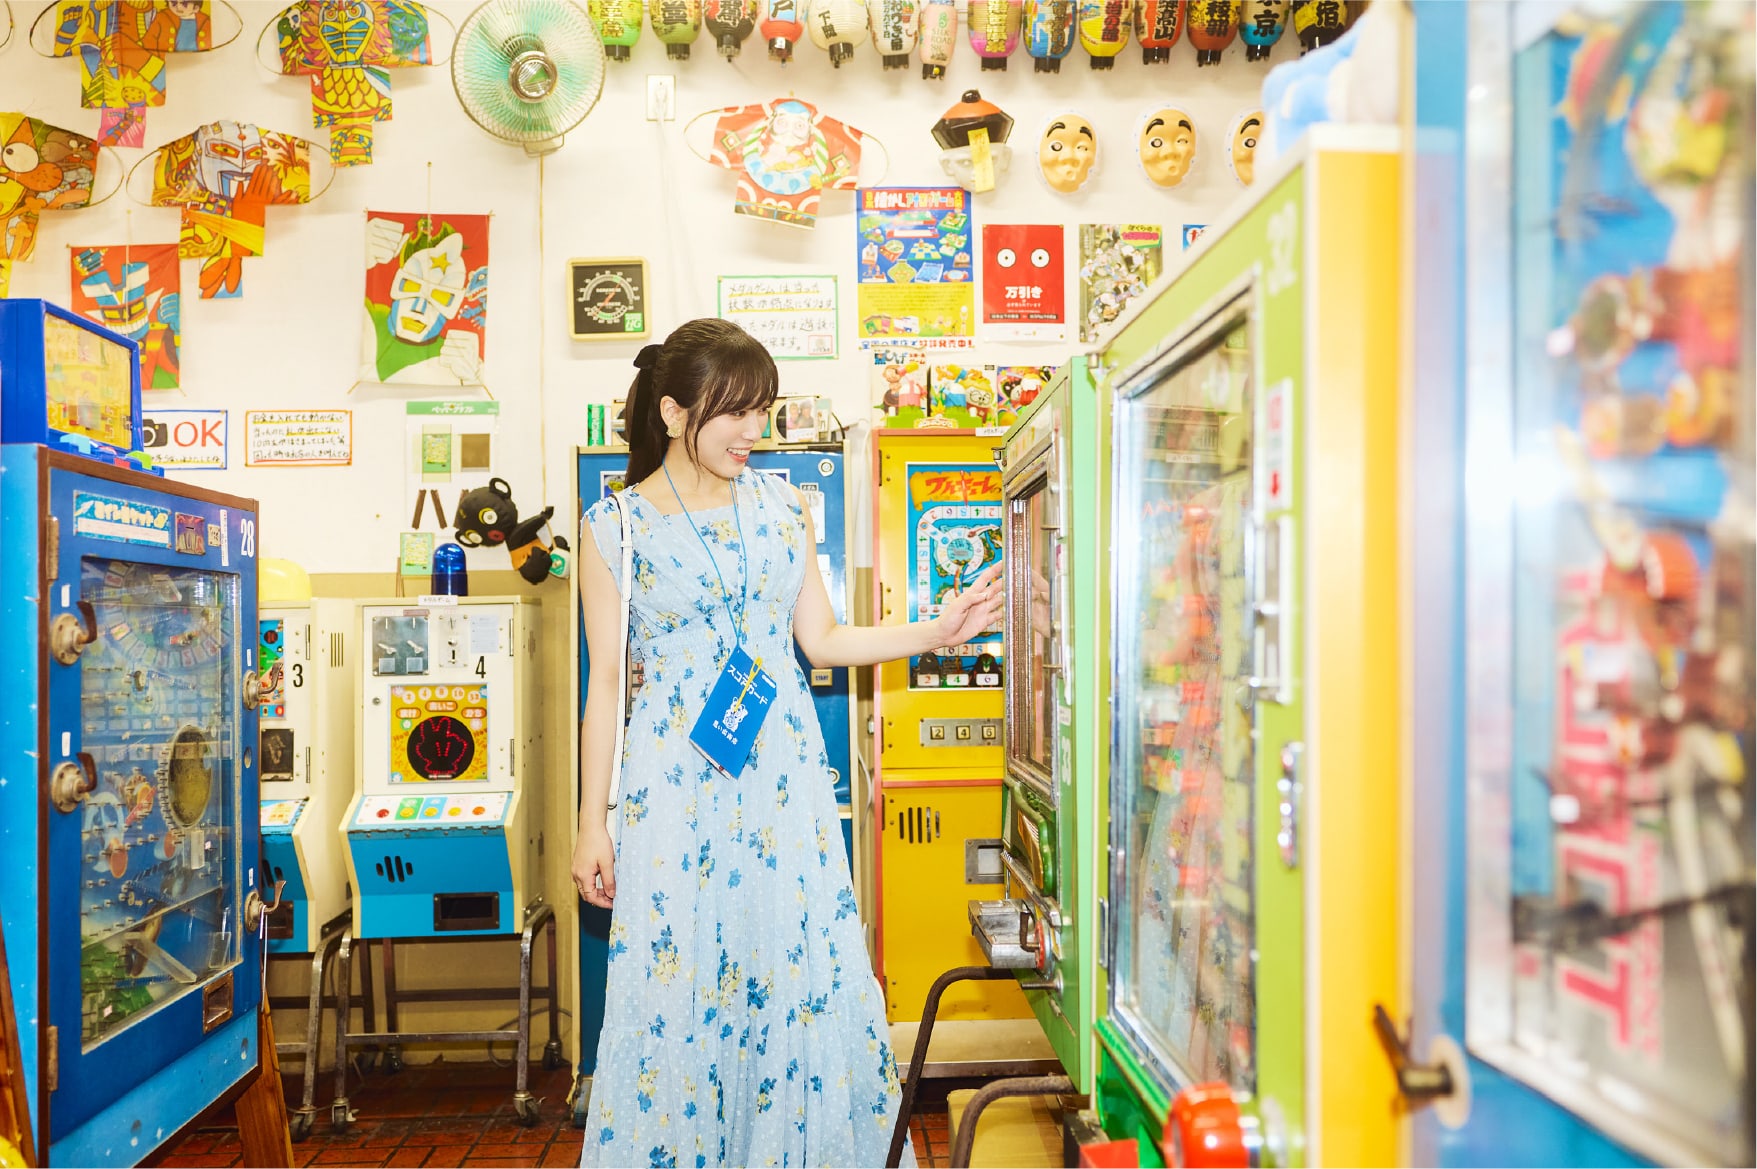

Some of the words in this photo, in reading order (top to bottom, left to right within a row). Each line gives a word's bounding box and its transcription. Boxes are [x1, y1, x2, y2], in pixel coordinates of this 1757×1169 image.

[1005, 286, 1044, 299] 万引き
[173, 419, 223, 447] OK
[240, 518, 255, 559] 28
[292, 663, 304, 688] 3
[475, 655, 486, 679] 4
[934, 728, 942, 738] 2
[960, 728, 967, 737] 4
